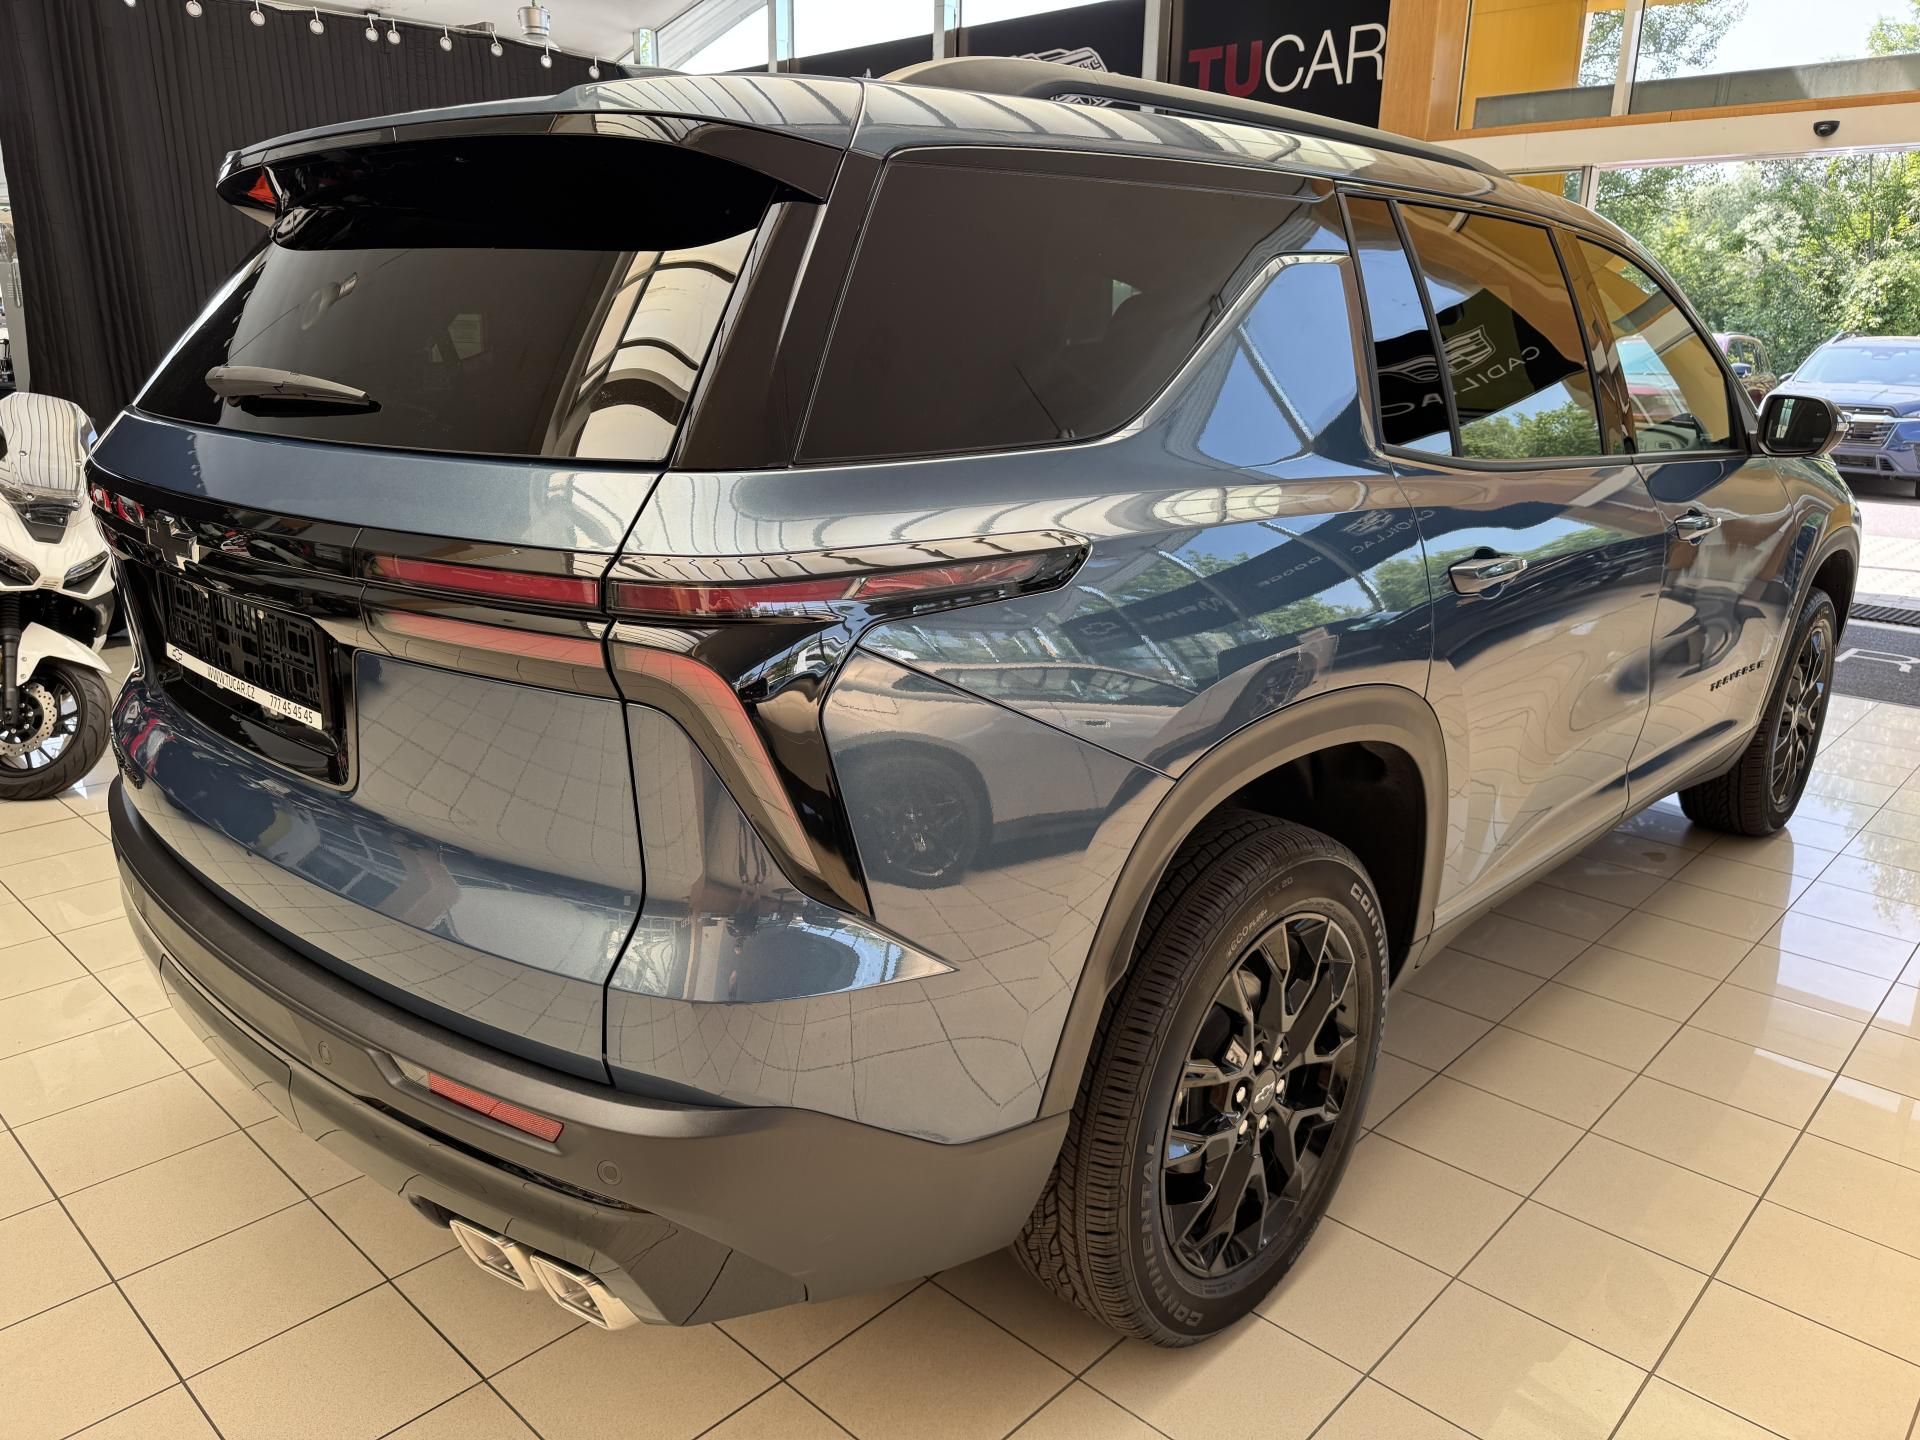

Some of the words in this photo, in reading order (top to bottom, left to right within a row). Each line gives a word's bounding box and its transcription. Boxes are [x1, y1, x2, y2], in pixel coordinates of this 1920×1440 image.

[1188, 22, 1386, 97] TUCAR
[207, 666, 255, 699] WWW.TUCAR.CZ
[270, 695, 281, 710] 777
[282, 700, 292, 715] 45
[293, 705, 302, 719] 45
[303, 710, 313, 724] 45
[1141, 1128, 1204, 1327] CONTINENTAL
